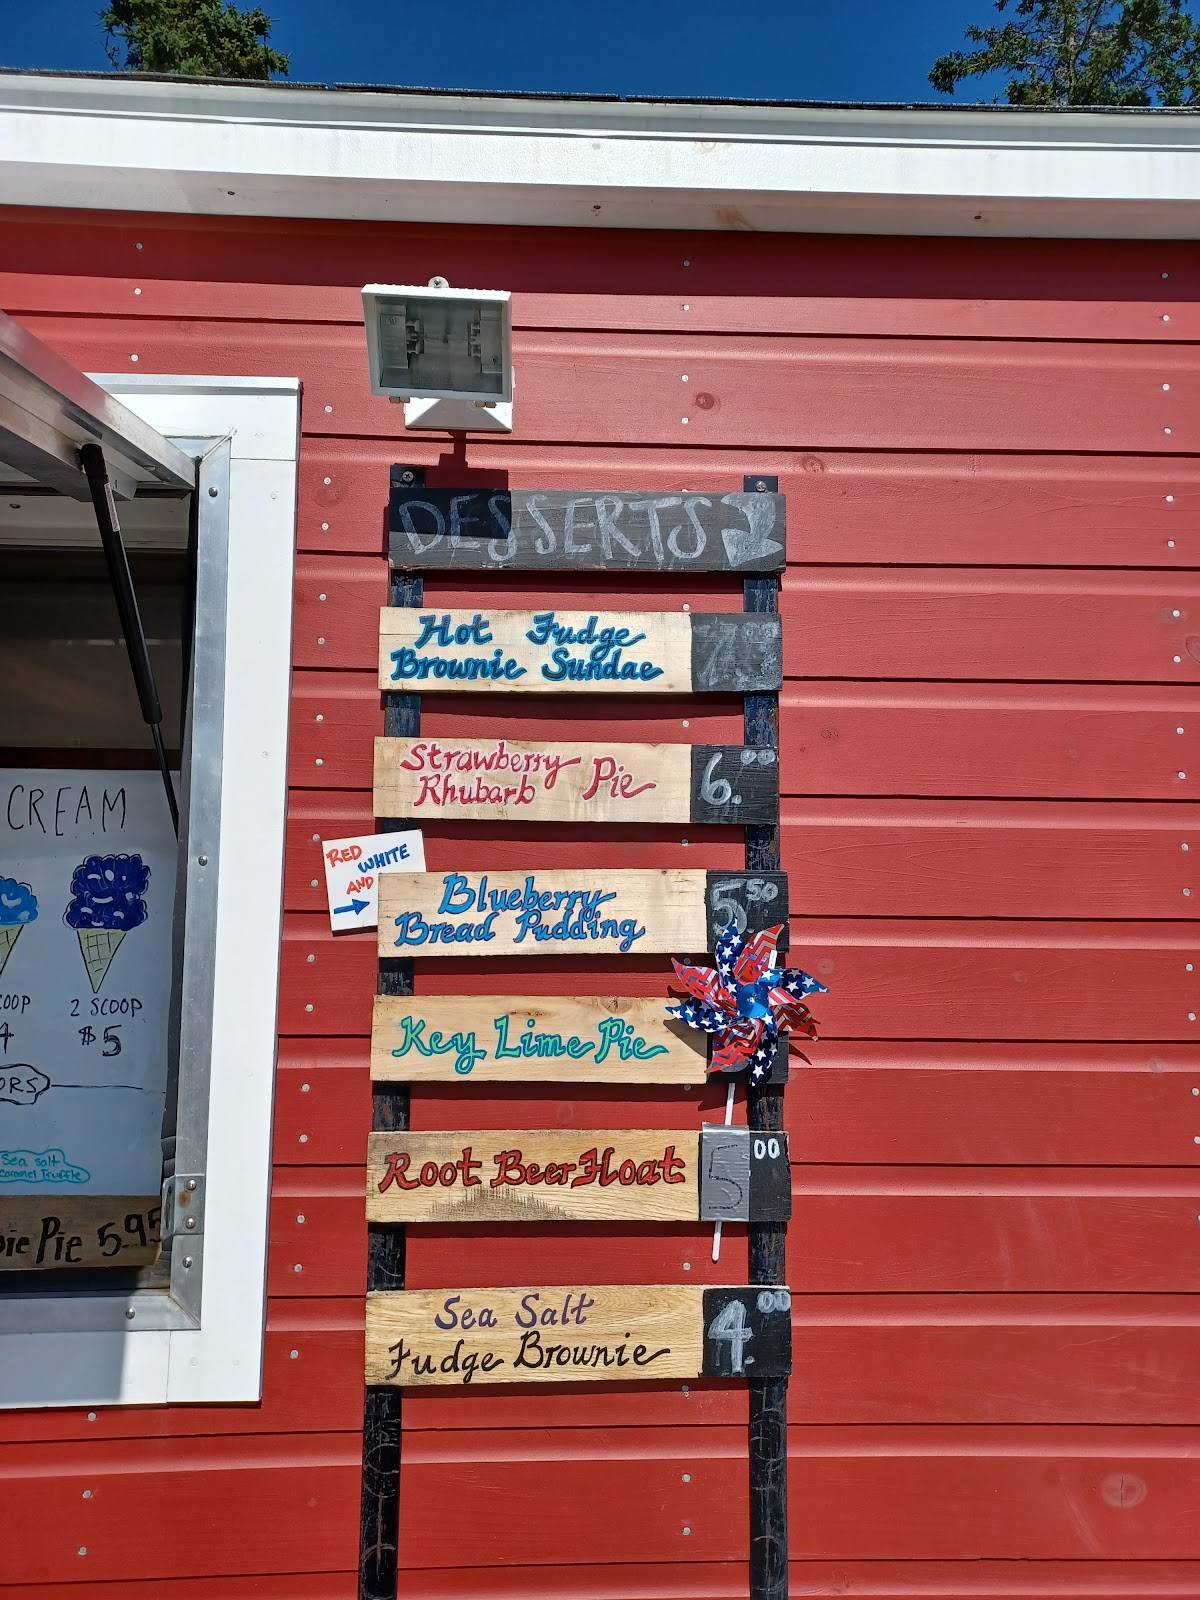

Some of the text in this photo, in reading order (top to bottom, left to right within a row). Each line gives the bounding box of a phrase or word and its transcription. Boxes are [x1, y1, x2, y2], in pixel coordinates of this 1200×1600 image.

[399, 494, 713, 562] DESSERTS
[414, 613, 494, 650] Hot
[525, 611, 647, 662] Fudge
[390, 648, 528, 682] Brownie
[541, 644, 665, 683] Sundae
[400, 741, 582, 790] Strawberry
[413, 756, 657, 807] Rhubarb Pie
[7, 784, 127, 836] CREAM
[326, 844, 363, 868] RED
[357, 843, 411, 874] WHITE
[346, 876, 374, 895] AND
[437, 872, 617, 921] Blueberry
[394, 909, 646, 953] Bread Pudding
[70, 997, 144, 1018] 2 SCOOP
[392, 1015, 669, 1075] Key Lime Pie
[1, 1153, 28, 1167] Sea
[378, 1145, 687, 1194] Root Beer Float
[36, 1216, 83, 1265] Pie
[434, 1293, 595, 1331] Sea Salt
[385, 1330, 672, 1383] Fudge Brownie
